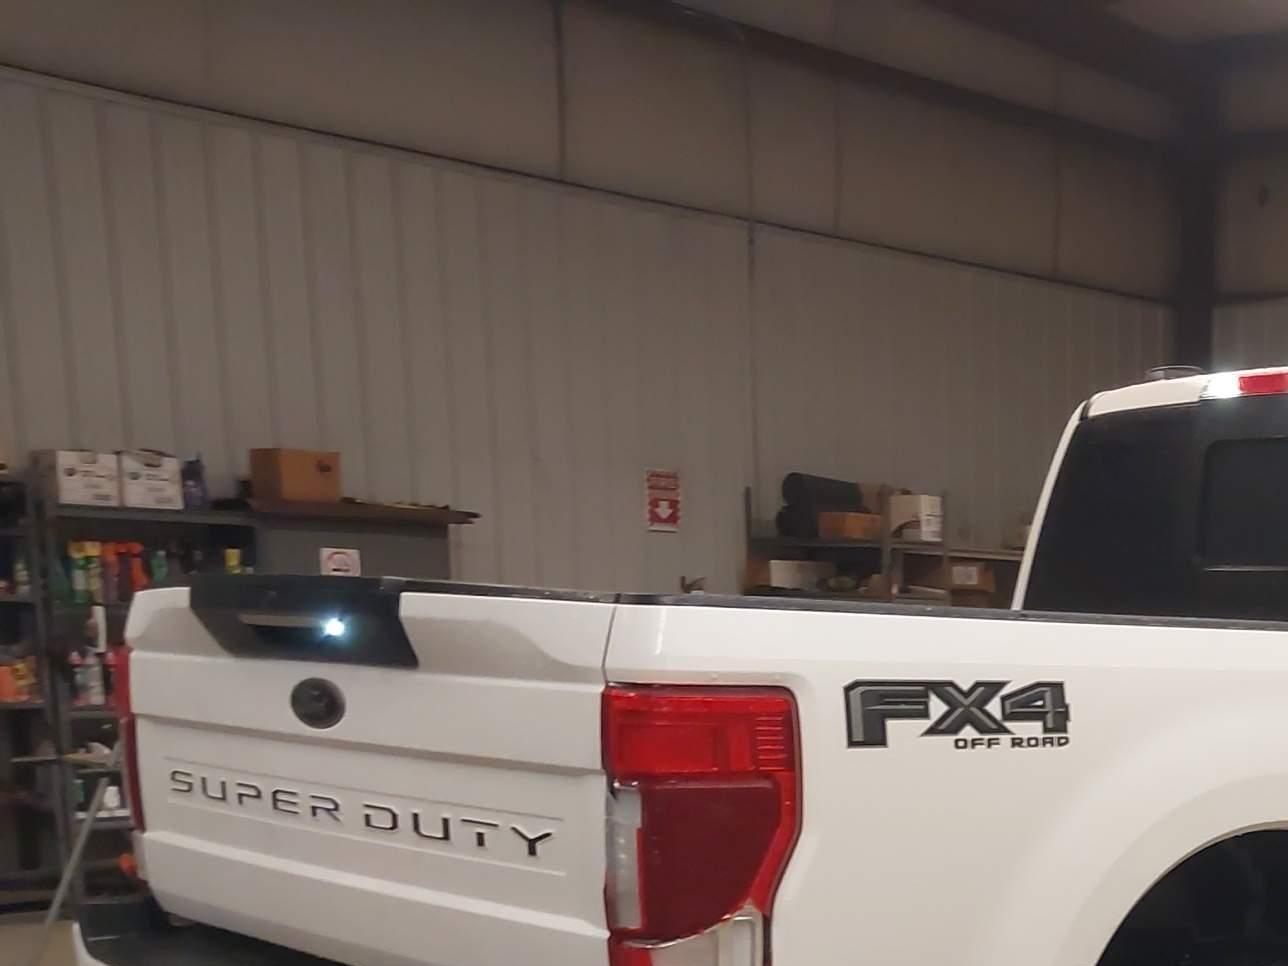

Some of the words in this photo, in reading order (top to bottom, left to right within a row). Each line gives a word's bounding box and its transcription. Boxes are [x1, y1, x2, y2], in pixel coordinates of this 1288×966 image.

[843, 679, 1070, 748] FX4
[954, 737, 1001, 750] OFF
[1010, 736, 1070, 748] ROAD
[169, 769, 342, 822] SUPER
[363, 802, 553, 857] DUTY
